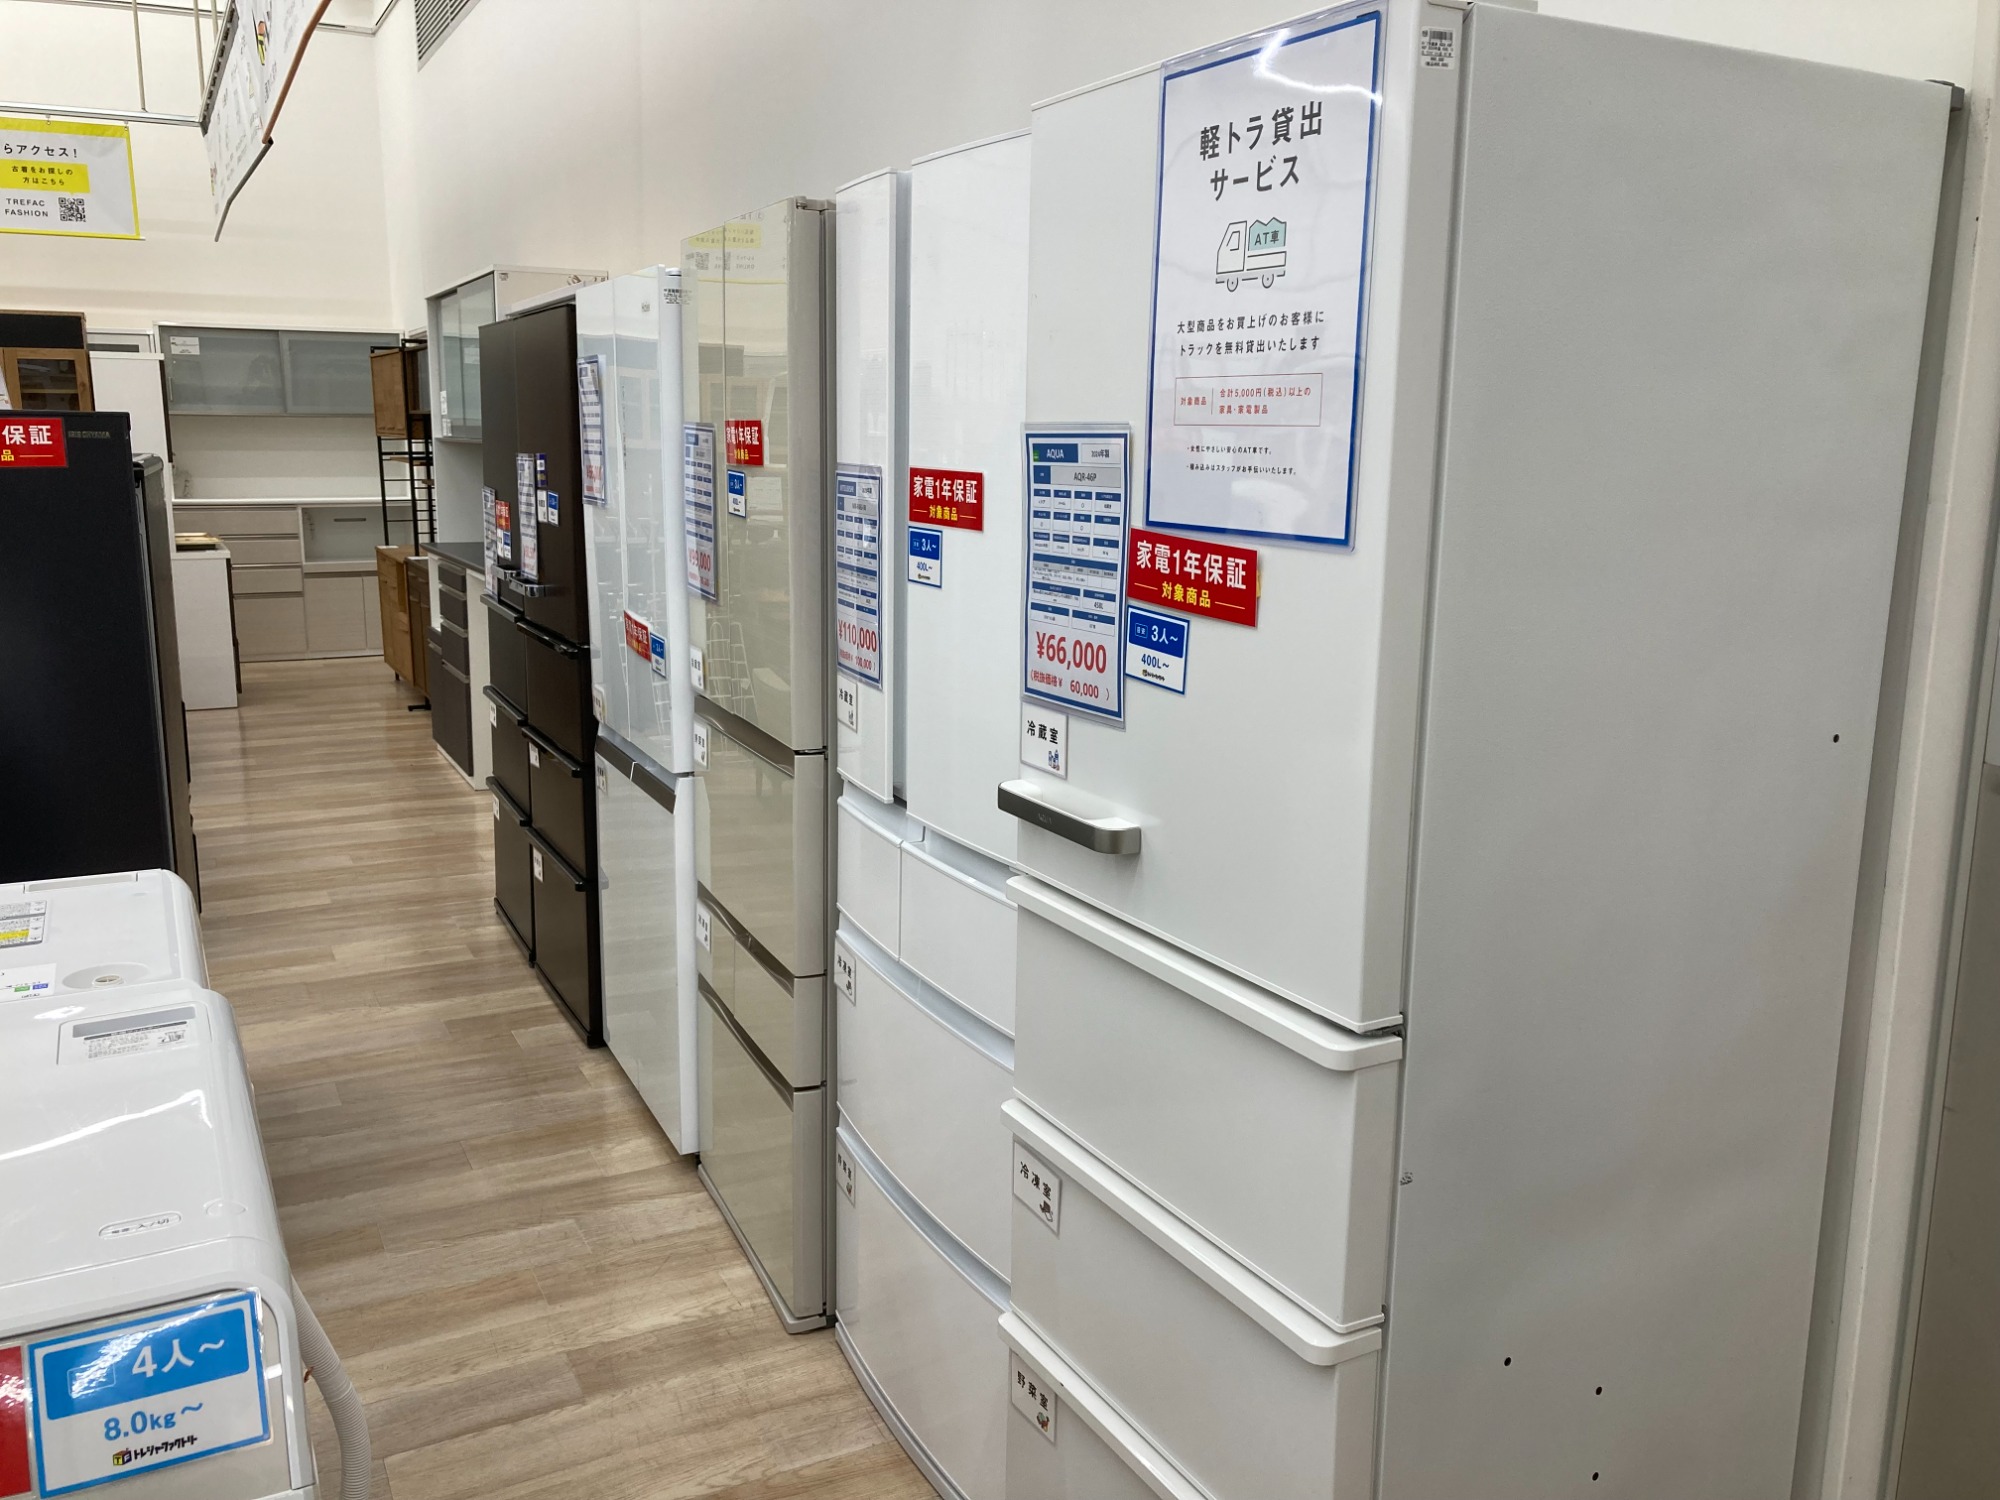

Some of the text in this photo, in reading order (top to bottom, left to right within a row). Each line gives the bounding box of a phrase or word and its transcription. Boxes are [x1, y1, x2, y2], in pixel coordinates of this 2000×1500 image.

[1200, 101, 1323, 161] 軽トラ貸出
[12, 165, 73, 176] 古着をお探しの
[1210, 155, 1299, 201] サービス
[23, 177, 65, 186] 方はこちら
[6, 198, 45, 207] TREFAC
[5, 209, 49, 217] FASHION
[1254, 230, 1280, 246] AT車
[1176, 310, 1325, 334] 大型商品をお買上げのお客様に
[1180, 336, 1320, 357] トラックを無料貸出いたします
[1180, 397, 1207, 406] 対象商品
[1219, 405, 1268, 415] 家具・家電製品
[1, 425, 53, 445] 保証
[1, 449, 14, 461] 品
[1046, 448, 1064, 458] AQUA
[913, 475, 978, 504] 家電1年保証
[929, 505, 958, 521] 対象商品
[1136, 540, 1247, 590] 家電1年保証
[1161, 581, 1211, 608] 対象商品
[838, 619, 877, 653] ¥110,000
[1036, 631, 1107, 674] ¥66,000
[1070, 680, 1099, 699] 60,000
[1027, 720, 1059, 744] 冷蔵室
[1020, 1161, 1051, 1201] 冷凍室
[1017, 1370, 1048, 1411] 野菜室
